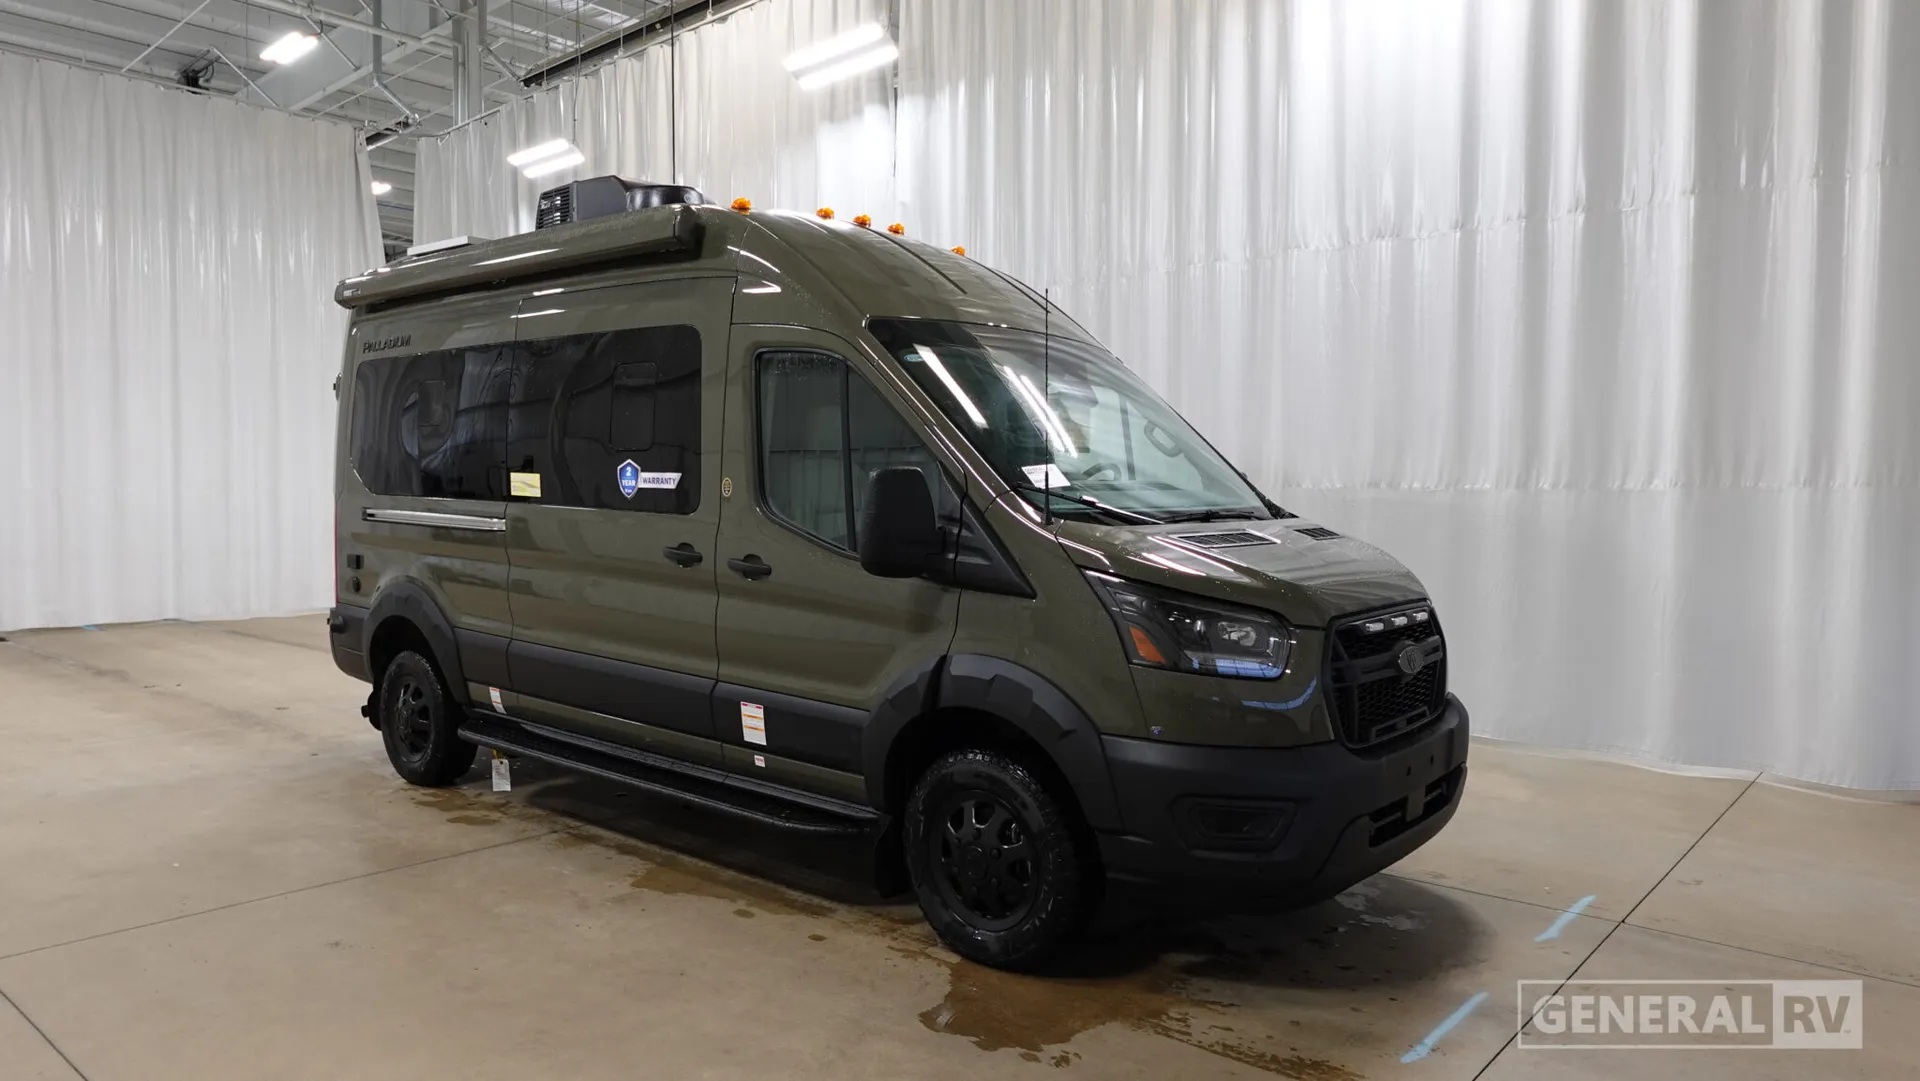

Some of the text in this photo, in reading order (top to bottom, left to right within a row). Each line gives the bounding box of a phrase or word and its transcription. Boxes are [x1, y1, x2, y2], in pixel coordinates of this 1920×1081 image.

[363, 334, 411, 354] PALLADIUM
[626, 466, 632, 476] 2
[621, 479, 636, 487] YEAR
[642, 477, 677, 485] WARRANTY
